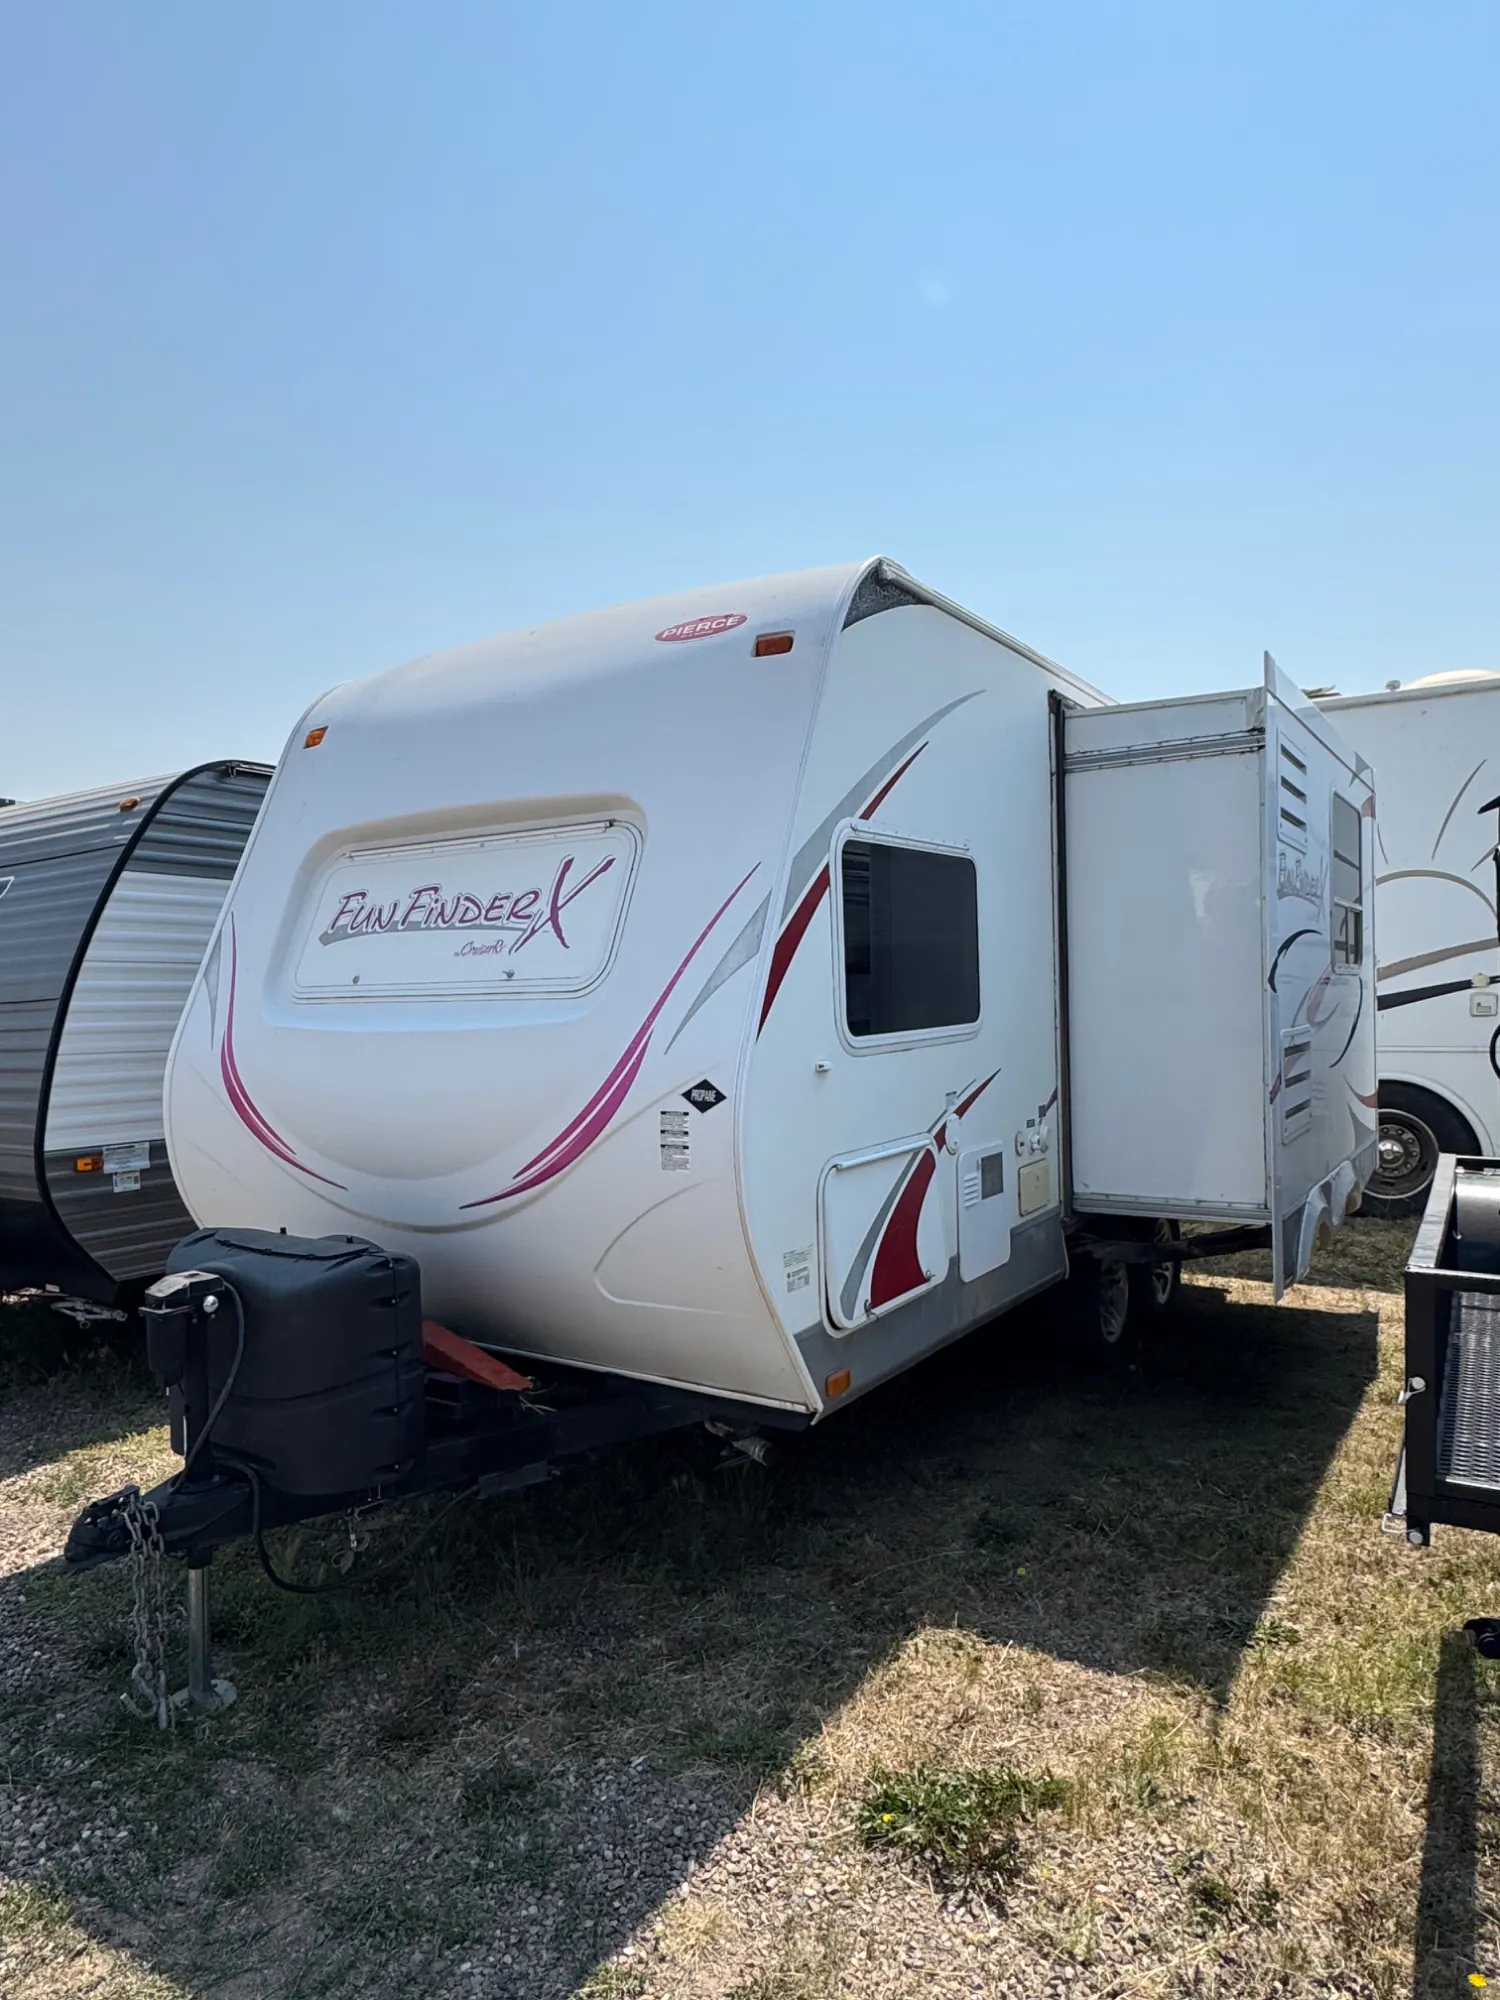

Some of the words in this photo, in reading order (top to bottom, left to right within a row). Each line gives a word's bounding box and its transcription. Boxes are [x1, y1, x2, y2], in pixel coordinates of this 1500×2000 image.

[661, 615, 740, 638] PIERCE
[329, 888, 399, 933] FUN
[511, 855, 615, 954] X
[690, 1089, 717, 1102] PROPANE
